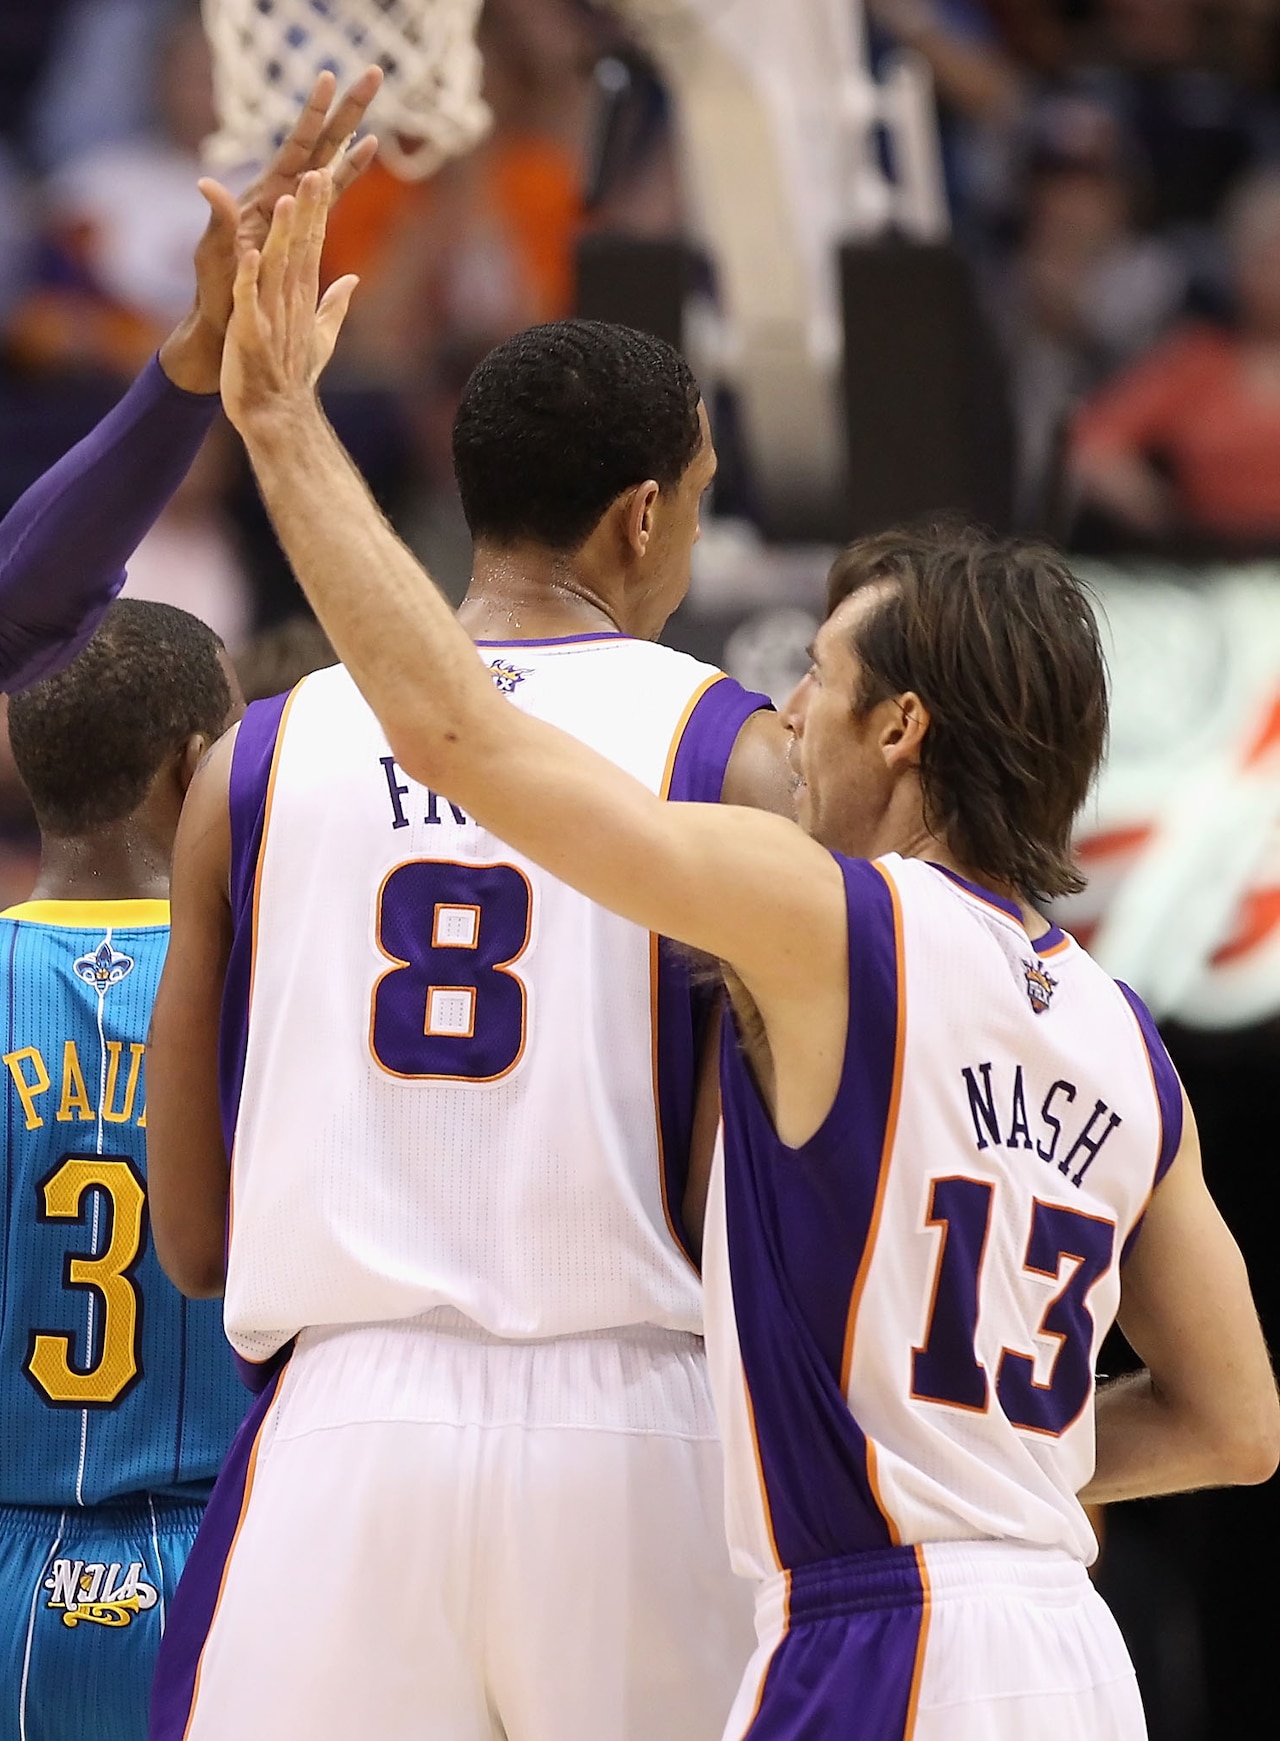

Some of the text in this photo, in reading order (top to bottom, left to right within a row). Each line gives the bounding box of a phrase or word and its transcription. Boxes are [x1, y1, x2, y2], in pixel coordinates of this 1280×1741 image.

[368, 857, 533, 1083] 8
[2, 1040, 148, 1131] PAU
[961, 1062, 1122, 1189] NASH
[20, 1151, 149, 1410] 3
[908, 1174, 1117, 1439] 13
